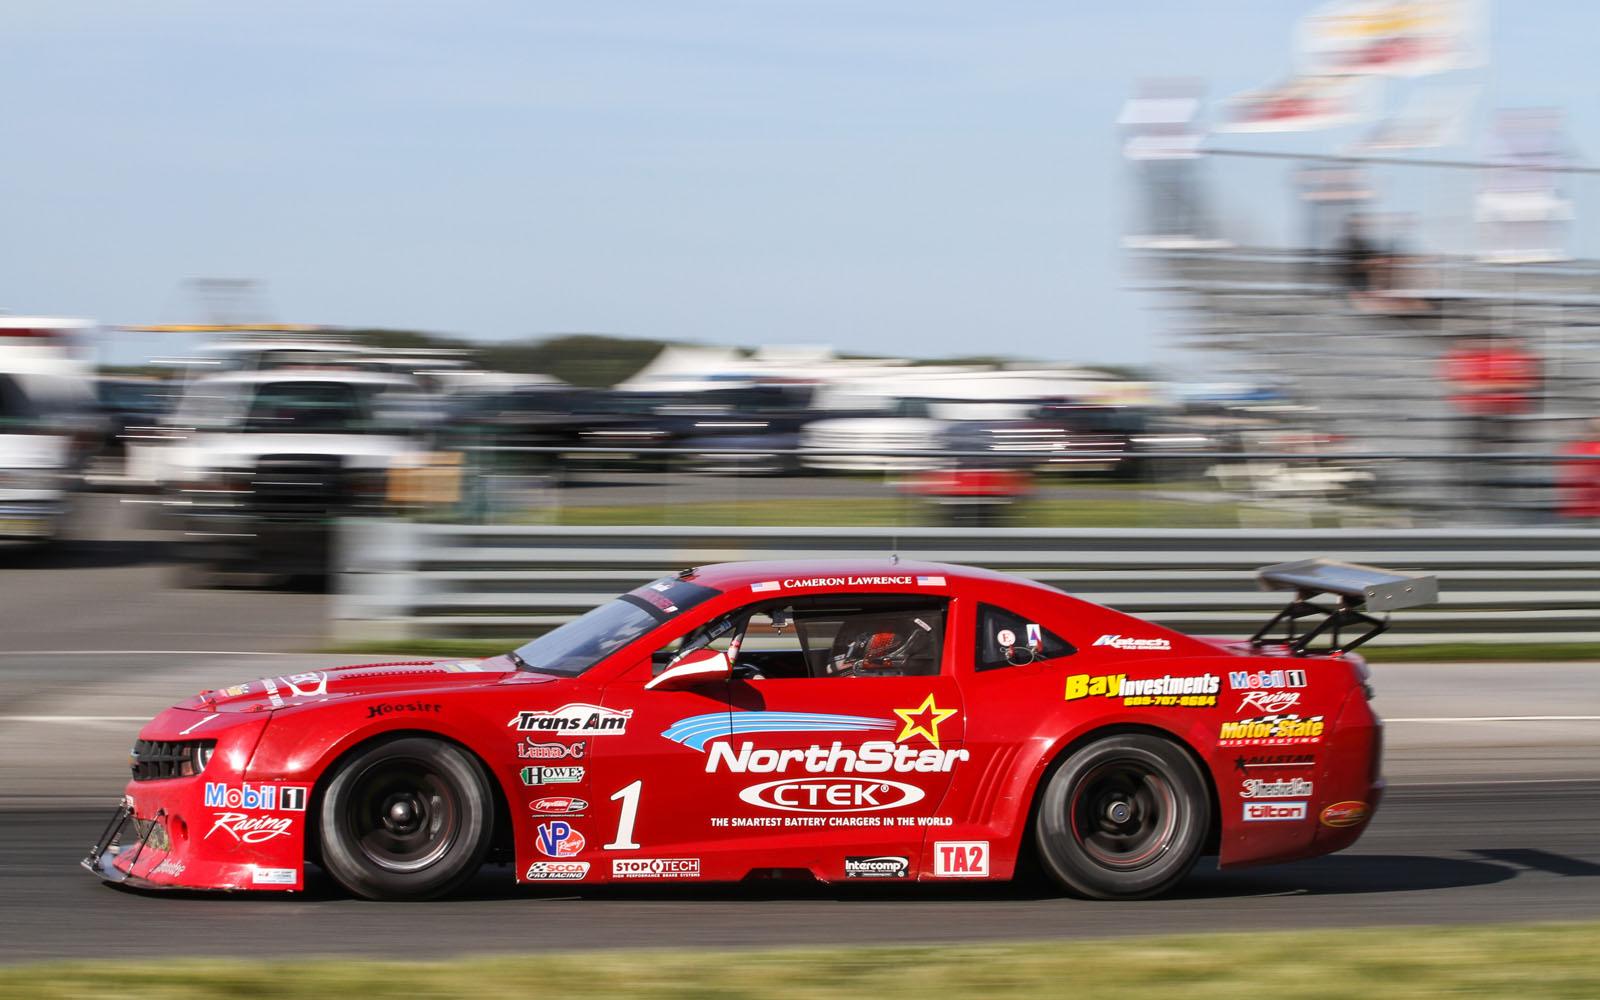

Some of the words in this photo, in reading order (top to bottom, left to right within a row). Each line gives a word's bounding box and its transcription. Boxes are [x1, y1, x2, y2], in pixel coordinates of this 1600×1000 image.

[784, 578, 844, 588] CAMERON
[848, 576, 912, 585] LAWRENCE
[1064, 673, 1126, 701] Bay
[1119, 673, 1220, 696] Investments
[1229, 670, 1286, 690] Mobil
[366, 701, 443, 719] Hoosier
[1235, 691, 1301, 714] Racing
[519, 712, 582, 730] Trans
[583, 712, 626, 730] Am
[1219, 737, 1321, 746] DISTRIBUTING
[705, 741, 970, 773] NorthStar
[527, 766, 578, 786] HOWE
[204, 782, 276, 810] Mobil
[603, 780, 643, 850] 1
[1248, 805, 1302, 818] tilton
[204, 812, 293, 843] Racing
[711, 817, 728, 827] THE
[731, 817, 782, 827] SMARTEST
[785, 817, 826, 827] BATTERY
[829, 817, 880, 826] CHARGERS
[883, 817, 893, 826] IN
[896, 817, 915, 826] THE
[917, 817, 953, 826] WORLD
[538, 822, 570, 856] VP
[547, 864, 585, 872] SCCA
[845, 859, 901, 873] Intercomp
[940, 846, 983, 872] TA2
